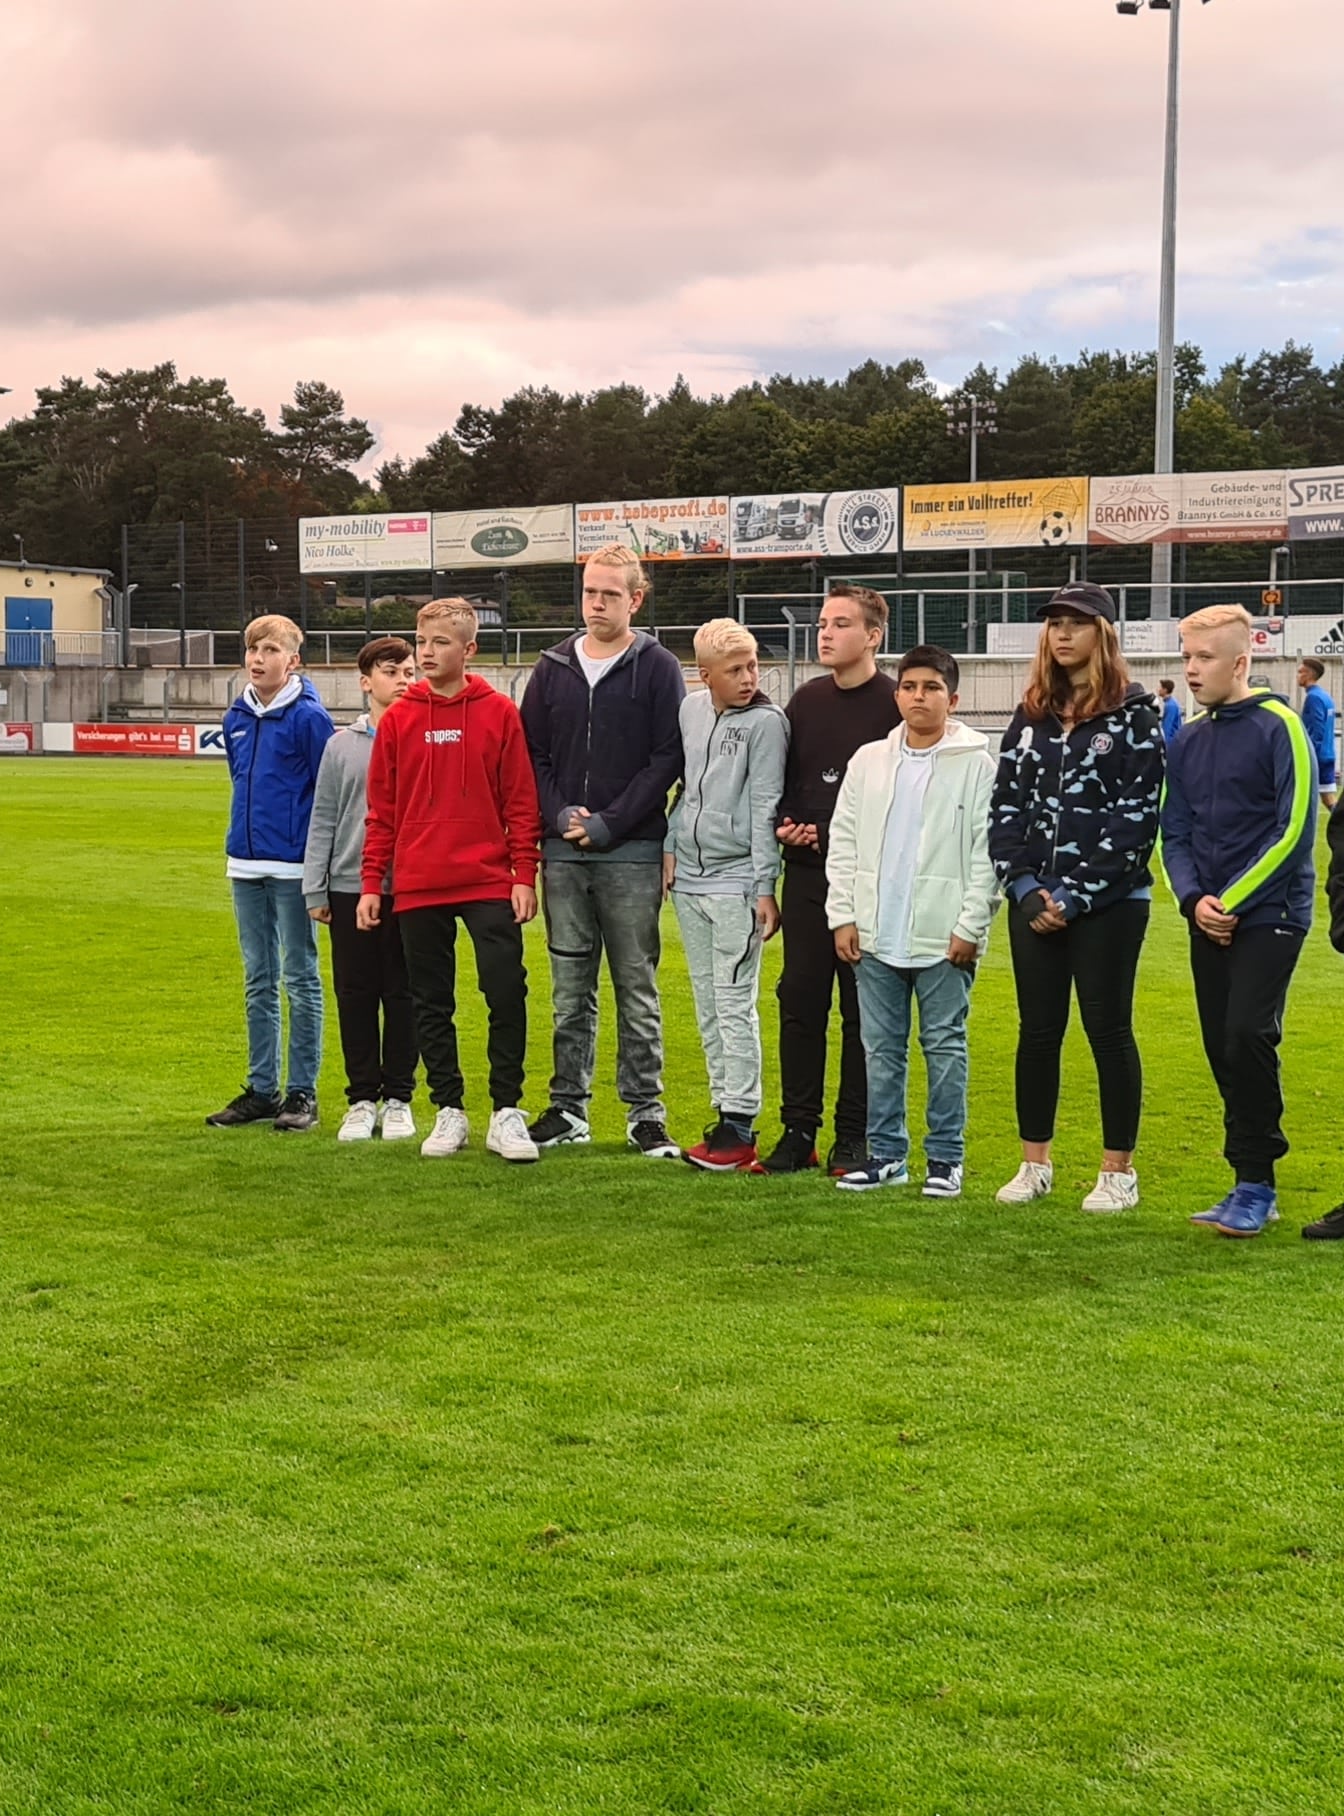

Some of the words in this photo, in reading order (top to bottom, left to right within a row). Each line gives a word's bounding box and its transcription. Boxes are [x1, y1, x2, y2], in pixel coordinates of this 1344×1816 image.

[1210, 482, 1259, 494] Gebäude-
[1263, 481, 1283, 492] und
[910, 499, 944, 514] Immer
[948, 496, 965, 512] ein
[968, 491, 1034, 511] Volltreffer!
[1188, 494, 1282, 508] Industriereinigung
[578, 499, 727, 523] www.hebeprofi.de
[1095, 504, 1170, 523] BRANNYS
[1177, 510, 1217, 522] Brannys
[305, 519, 386, 540] my-mobility
[304, 545, 325, 558] Nico
